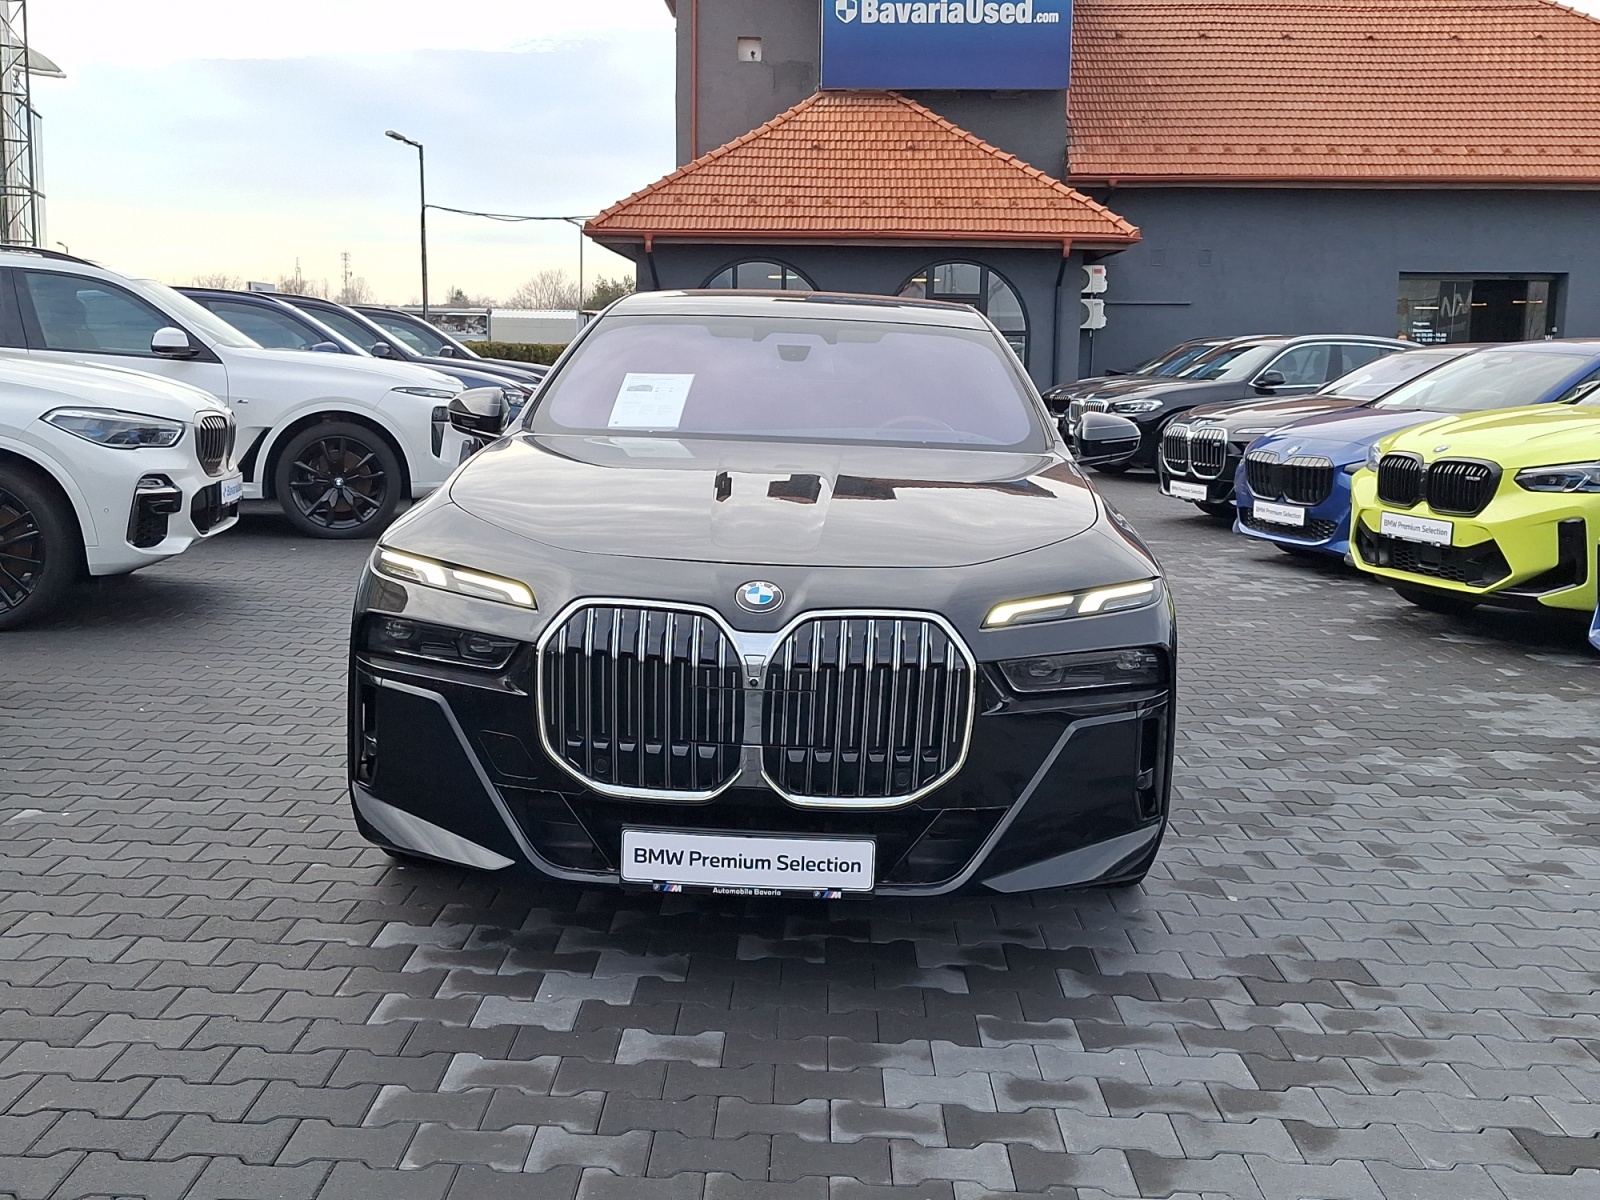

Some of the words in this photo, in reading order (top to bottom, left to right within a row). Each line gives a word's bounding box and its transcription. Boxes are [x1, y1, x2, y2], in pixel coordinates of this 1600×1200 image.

[861, 0, 1059, 24] BavariaUsed.com
[1384, 519, 1397, 527] BMW
[1398, 522, 1420, 532] Premium
[1422, 525, 1448, 536] Selection
[634, 848, 684, 865] BMW
[689, 851, 771, 870] Premium
[776, 855, 861, 873] Selection
[712, 887, 752, 896] Automobile
